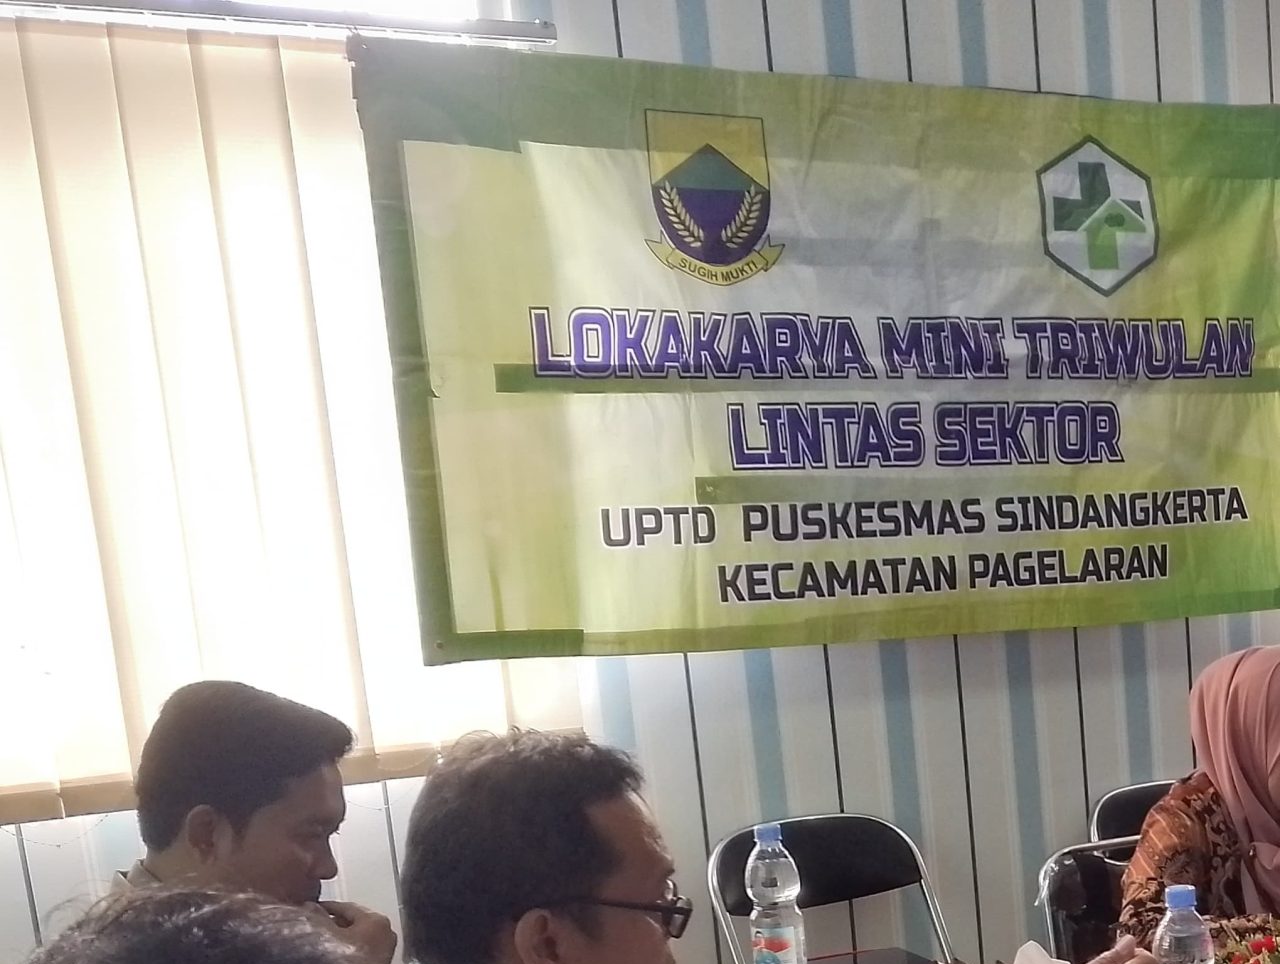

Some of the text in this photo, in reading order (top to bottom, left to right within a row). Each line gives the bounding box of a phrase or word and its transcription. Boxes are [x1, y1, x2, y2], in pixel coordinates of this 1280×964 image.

[679, 258, 758, 282] SUGIH MUKTI
[529, 306, 1255, 379] LOKAKARYA MINI TRIWULAN
[727, 400, 1124, 471] LINTAS SEKTOR
[601, 487, 1248, 546] UPTD PUSKESMAS SINDANGKERTA
[718, 544, 1168, 603] KECAMATAN PAGELARAN
